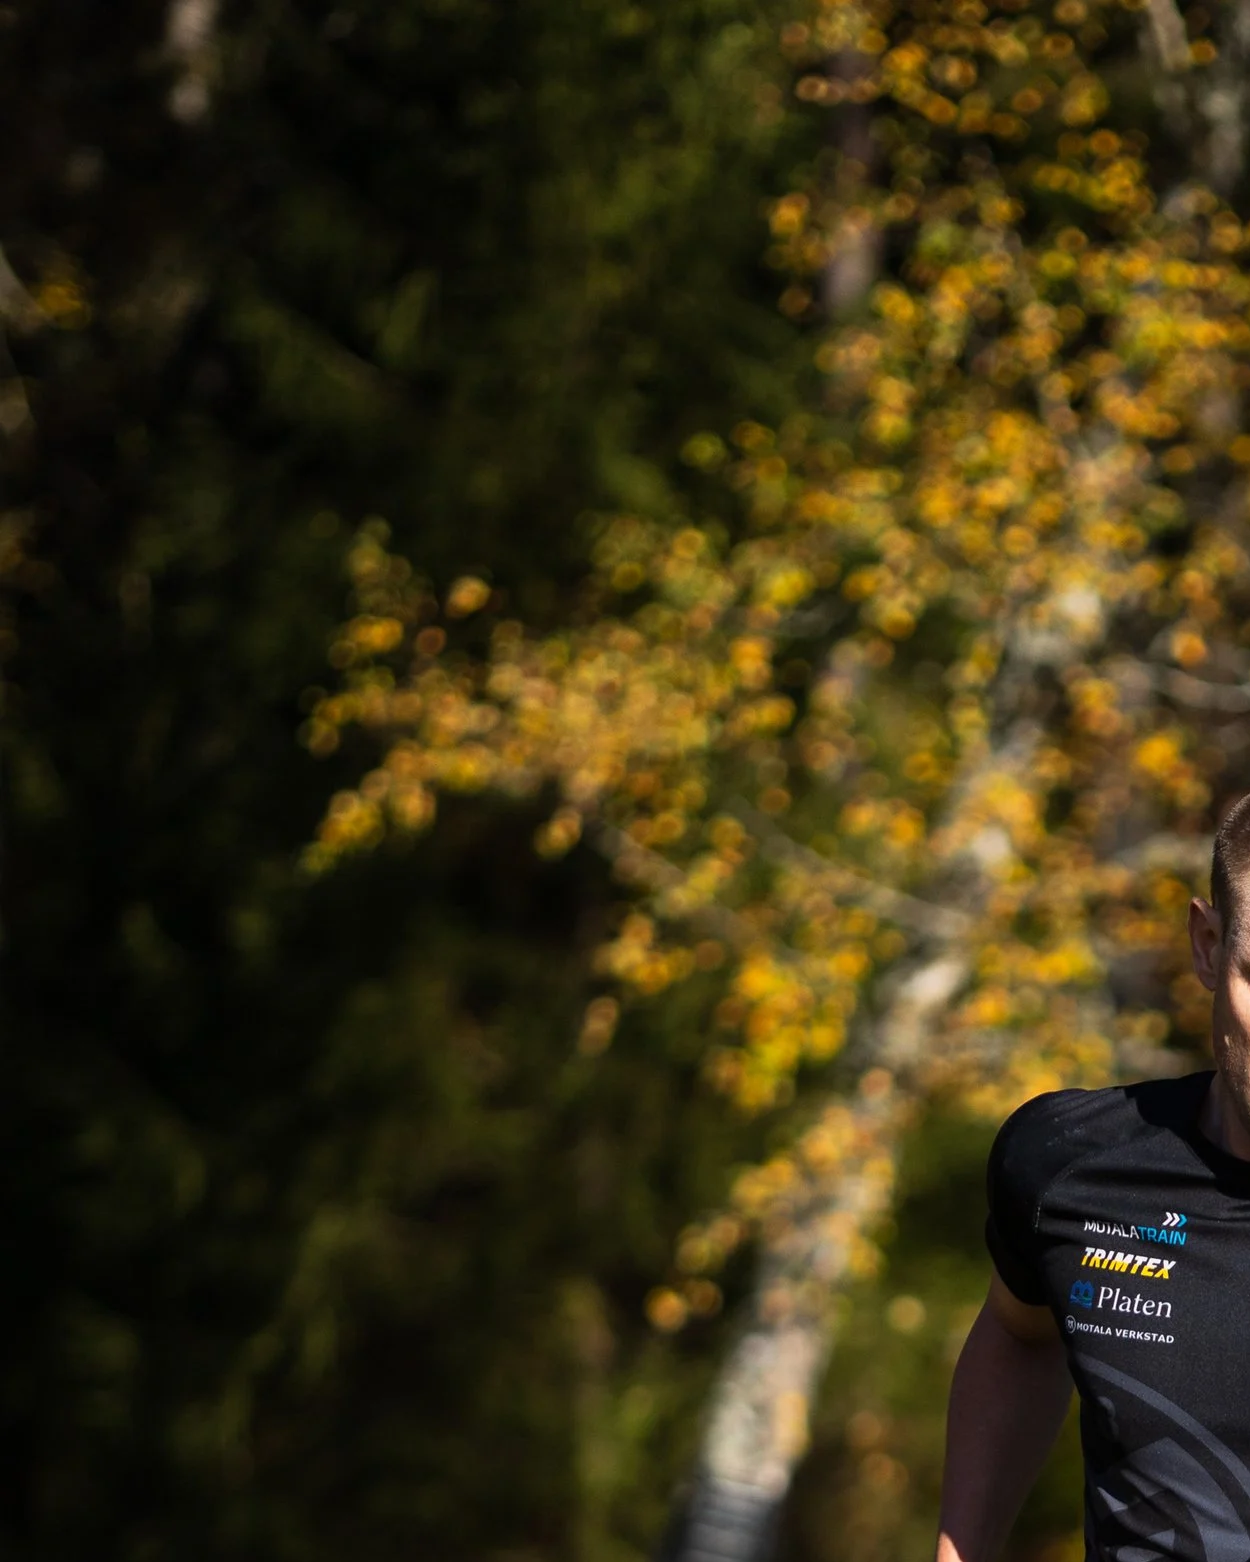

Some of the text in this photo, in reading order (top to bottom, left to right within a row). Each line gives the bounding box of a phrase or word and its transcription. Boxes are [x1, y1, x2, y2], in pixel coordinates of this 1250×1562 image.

[1081, 1247, 1177, 1279] TRIMTEX
[1097, 1286, 1173, 1318] Platen
[1076, 1322, 1175, 1344] MOTALA VERKSTAD
